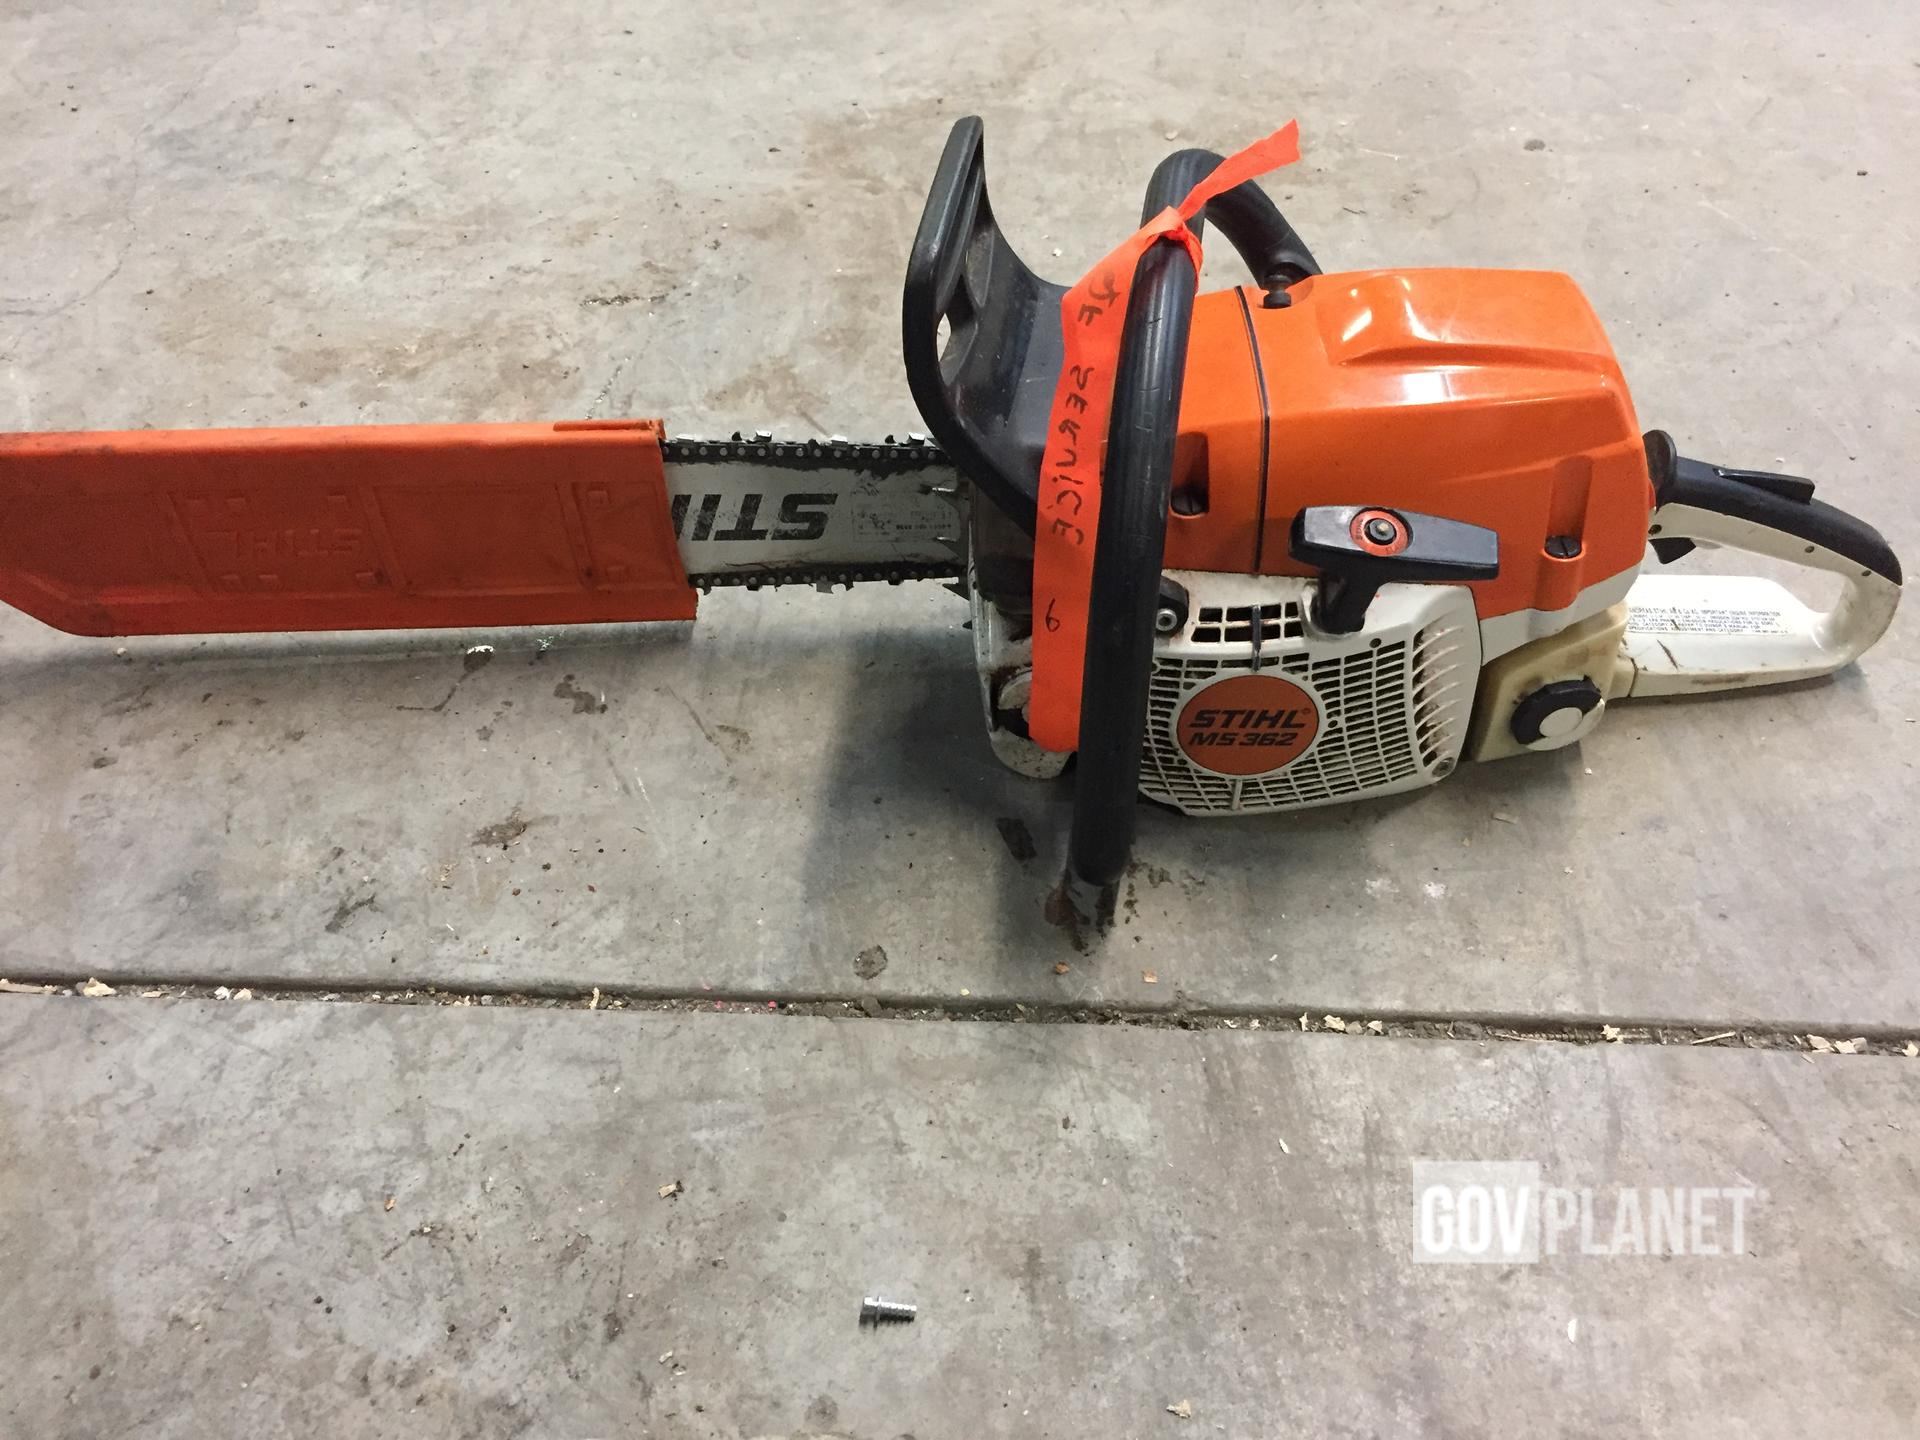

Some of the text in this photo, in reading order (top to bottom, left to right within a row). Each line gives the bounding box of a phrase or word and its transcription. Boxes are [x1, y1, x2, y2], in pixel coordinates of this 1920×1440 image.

[1188, 708, 1306, 729] STIHL
[1189, 733, 1298, 746] MS 362
